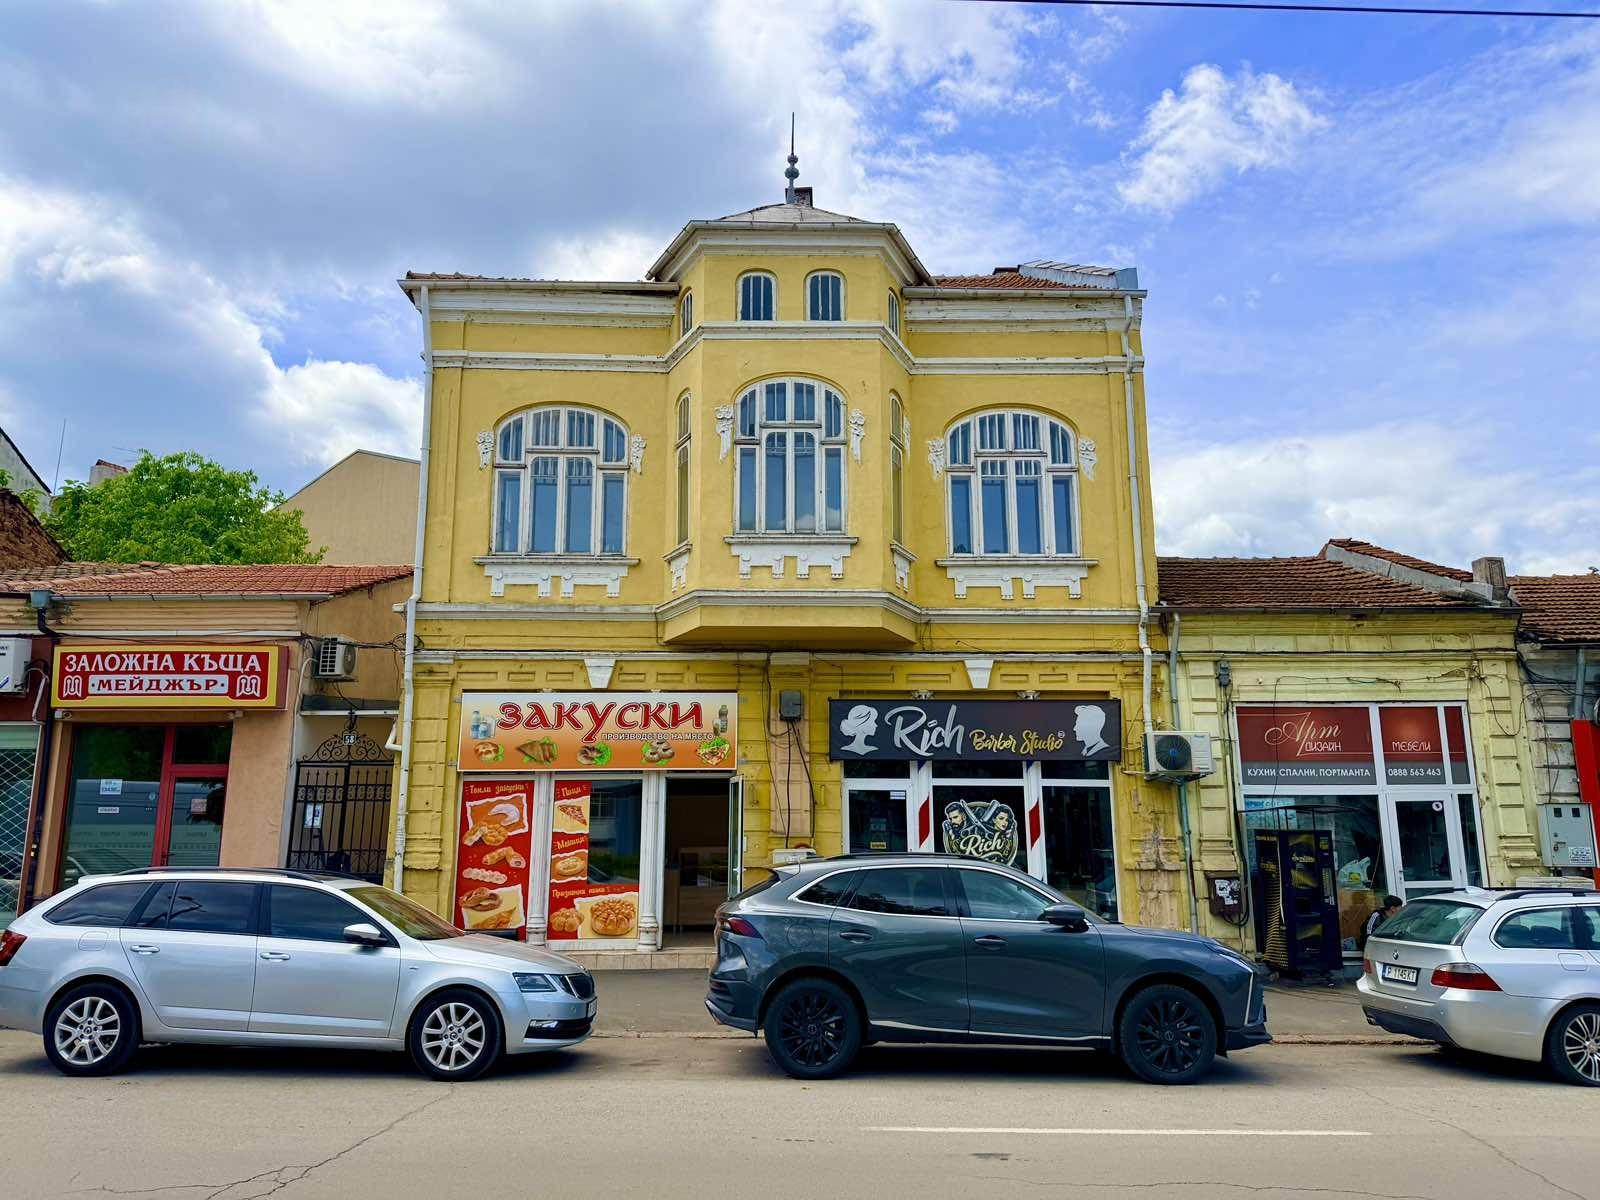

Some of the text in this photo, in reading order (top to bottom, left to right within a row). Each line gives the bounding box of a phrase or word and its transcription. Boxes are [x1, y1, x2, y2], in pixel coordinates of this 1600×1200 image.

[65, 653, 262, 674] ЗАЛОЖНА КЪЩА
[97, 676, 218, 692] МЕЙДЖЪР
[497, 701, 704, 743] ЗАКУСКИ
[671, 733, 683, 741] НА
[687, 733, 714, 741] МЯСТО
[884, 704, 1063, 757] Rich Barber Studio
[1392, 741, 1431, 751] МЕБЕЛИ
[1319, 768, 1371, 777] ПОРТМАНТА
[1388, 768, 1441, 777] 0888 563 463
[960, 832, 1004, 858] Rich
